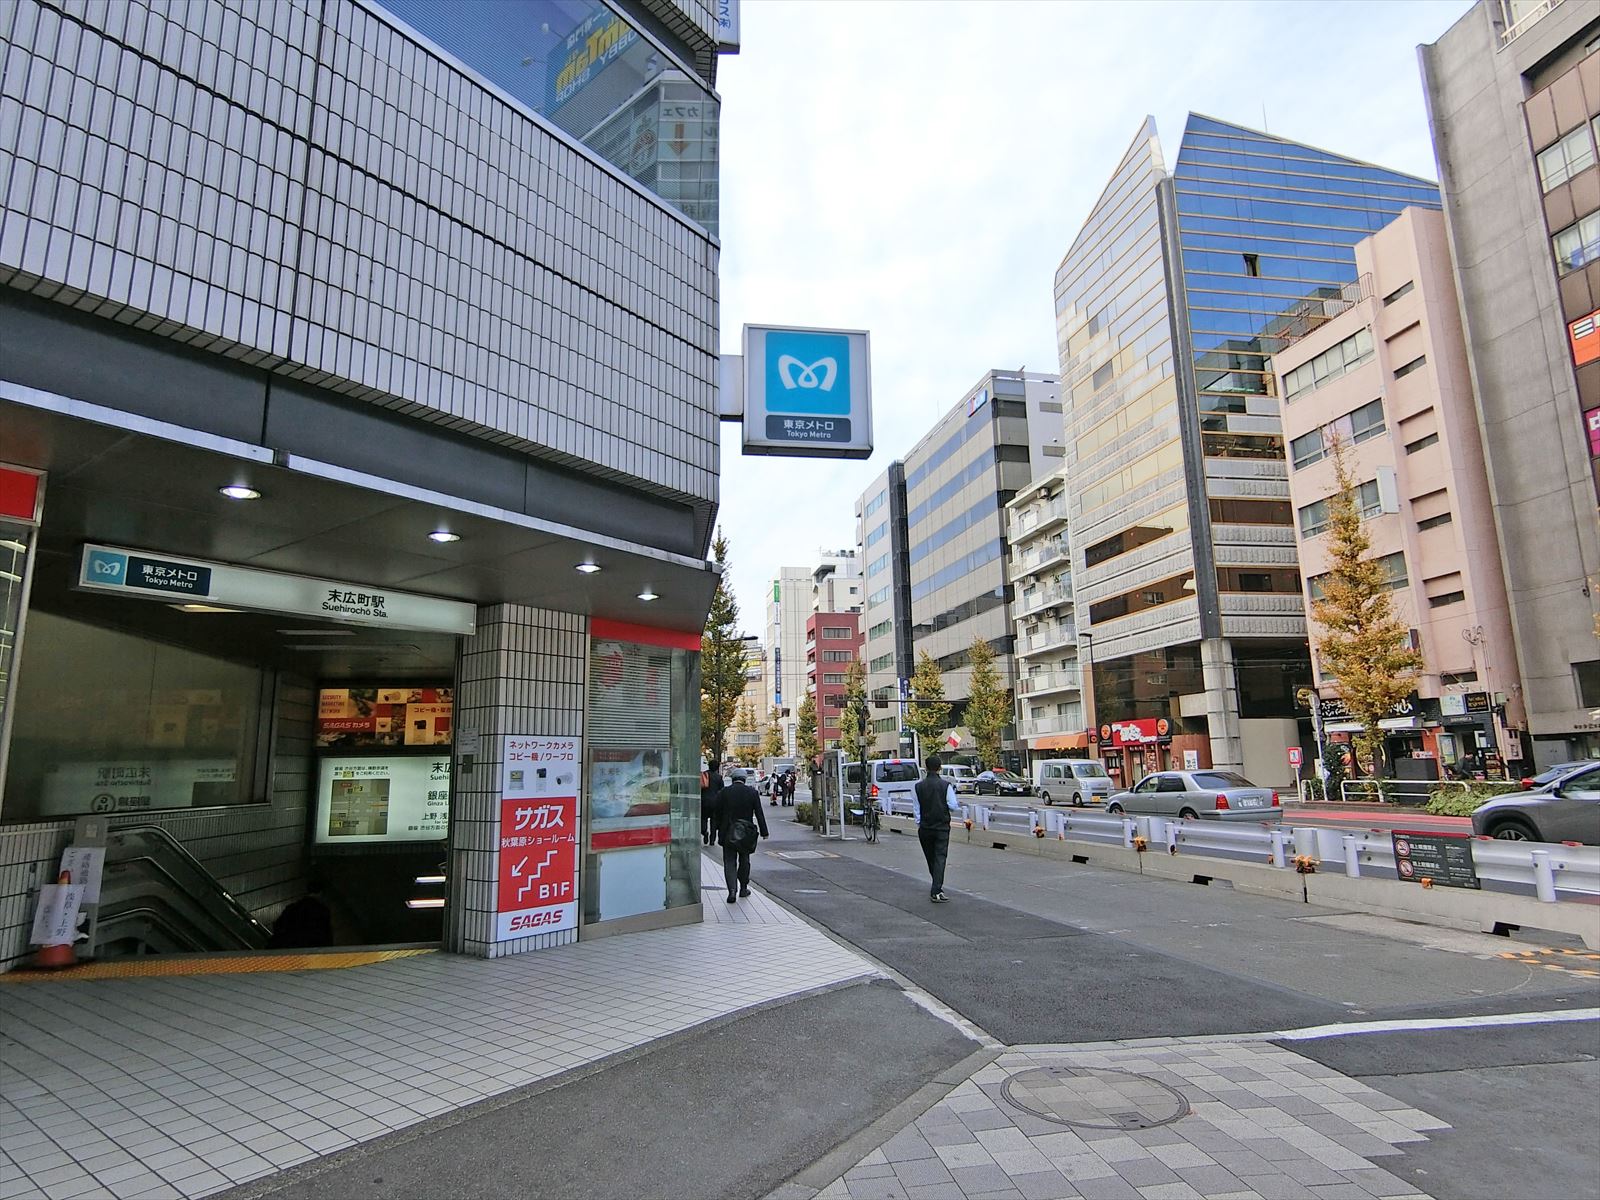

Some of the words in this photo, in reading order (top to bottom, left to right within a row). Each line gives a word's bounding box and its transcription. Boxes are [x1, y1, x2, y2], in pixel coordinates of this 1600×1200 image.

[783, 419, 834, 430] 東京メトロ
[786, 430, 808, 439] Tokyo
[809, 431, 832, 439] Metro
[142, 564, 198, 581] 東京メトロ
[144, 575, 168, 586] Tokyo
[169, 579, 193, 589] Metro
[327, 589, 385, 609] 末広町駅
[373, 608, 389, 618] Sta.
[509, 741, 574, 750] ネットワークカメラ
[428, 790, 448, 800] 銀座
[422, 812, 438, 821] 上野
[515, 804, 564, 831] サガス
[501, 833, 575, 848] 秋葉原ショールーム
[539, 881, 570, 899] B1F
[509, 909, 563, 932] SAGAS
